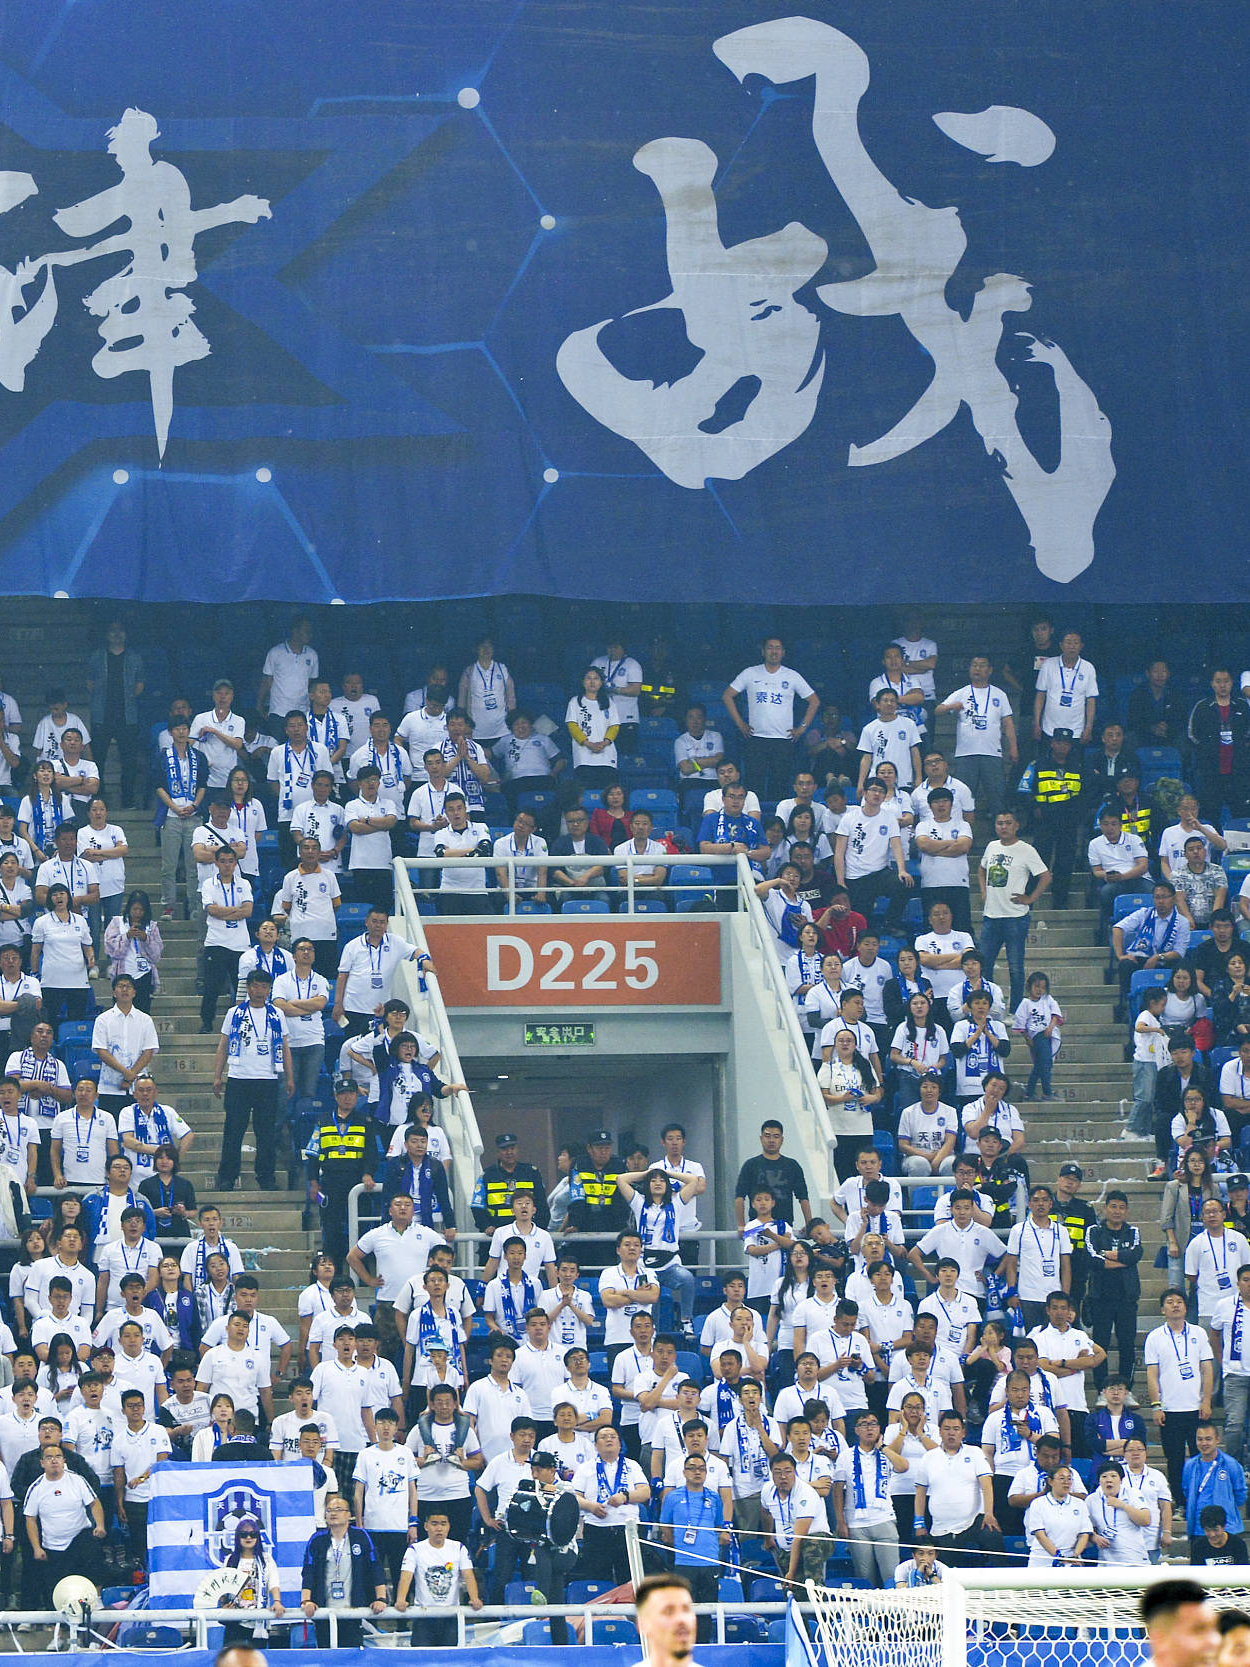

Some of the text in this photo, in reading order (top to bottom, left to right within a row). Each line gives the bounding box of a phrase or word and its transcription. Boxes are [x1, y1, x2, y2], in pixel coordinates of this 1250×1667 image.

[756, 691, 783, 704] 泰达
[487, 935, 659, 991] D225
[535, 1026, 584, 1036] 安全出口
[230, 1217, 243, 1227] 12
[204, 1529, 275, 1550] TEA
